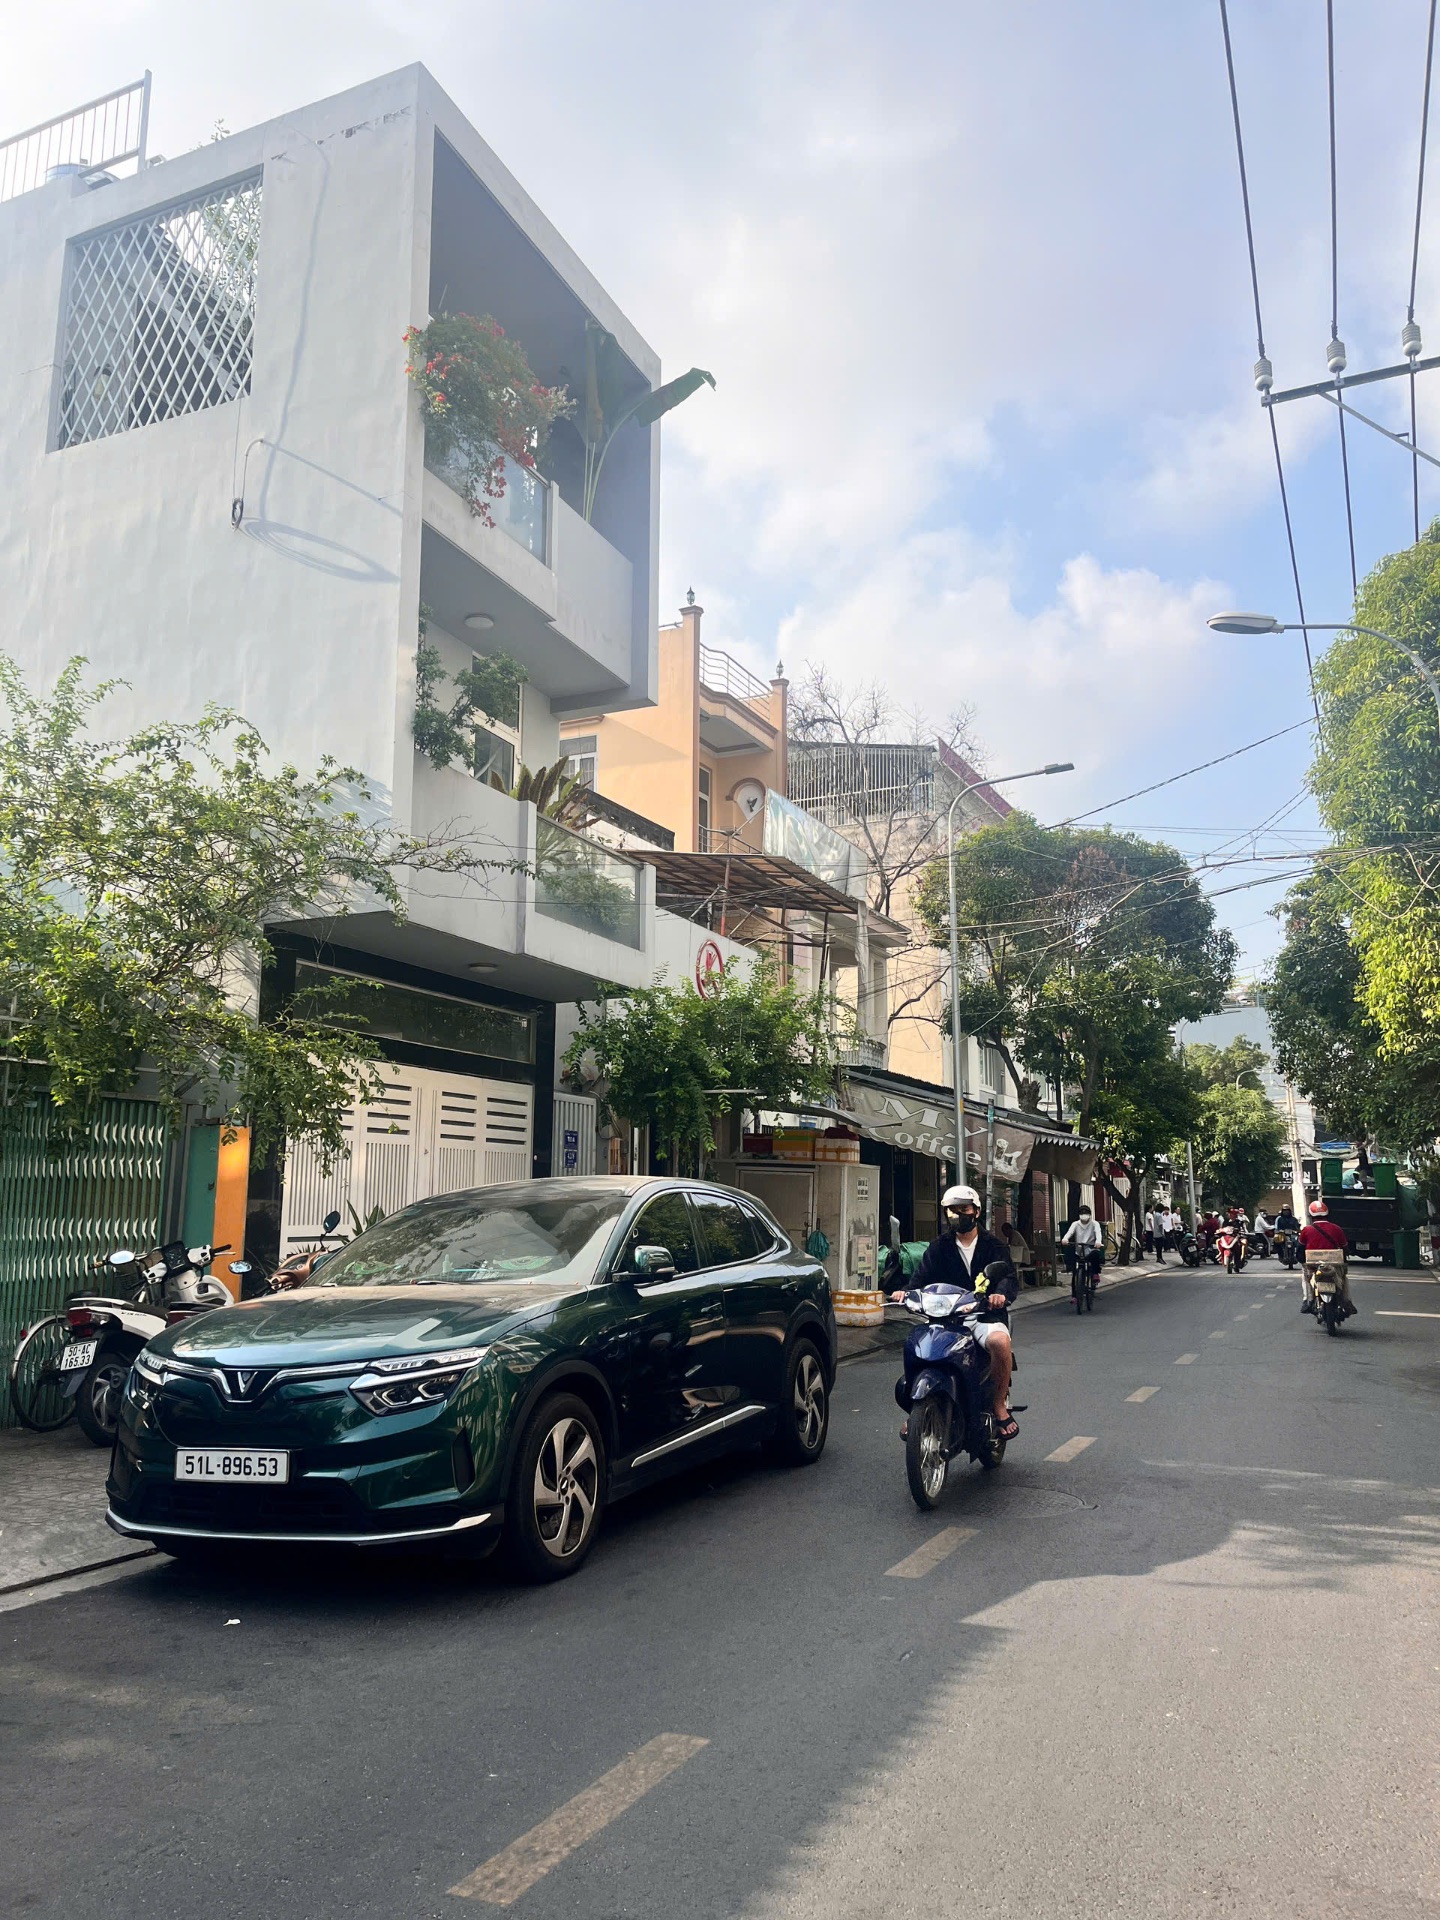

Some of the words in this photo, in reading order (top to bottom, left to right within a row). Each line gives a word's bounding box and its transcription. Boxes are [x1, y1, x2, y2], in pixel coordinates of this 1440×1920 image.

[68, 1344, 91, 1358] 50-AC
[64, 1354, 91, 1369] 165.33
[185, 1455, 278, 1477] 51L-896.53
